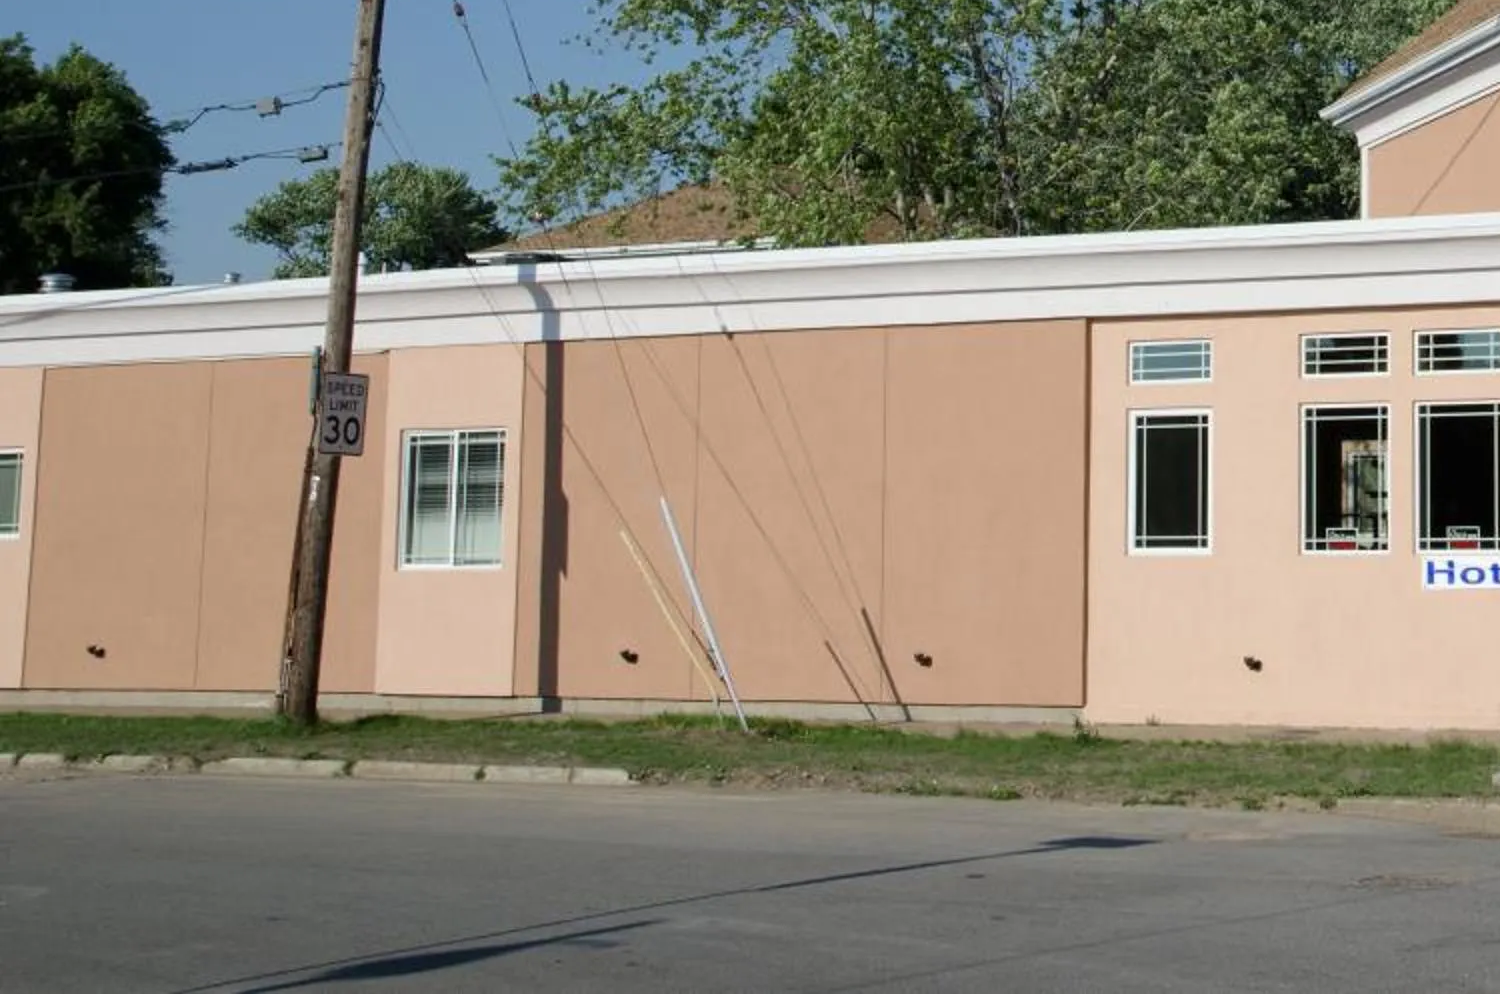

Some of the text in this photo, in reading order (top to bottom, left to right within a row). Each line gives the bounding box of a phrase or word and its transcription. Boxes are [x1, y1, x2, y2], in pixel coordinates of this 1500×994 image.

[327, 382, 364, 396] SPEED
[329, 398, 358, 411] LIMIT
[324, 415, 361, 446] 30
